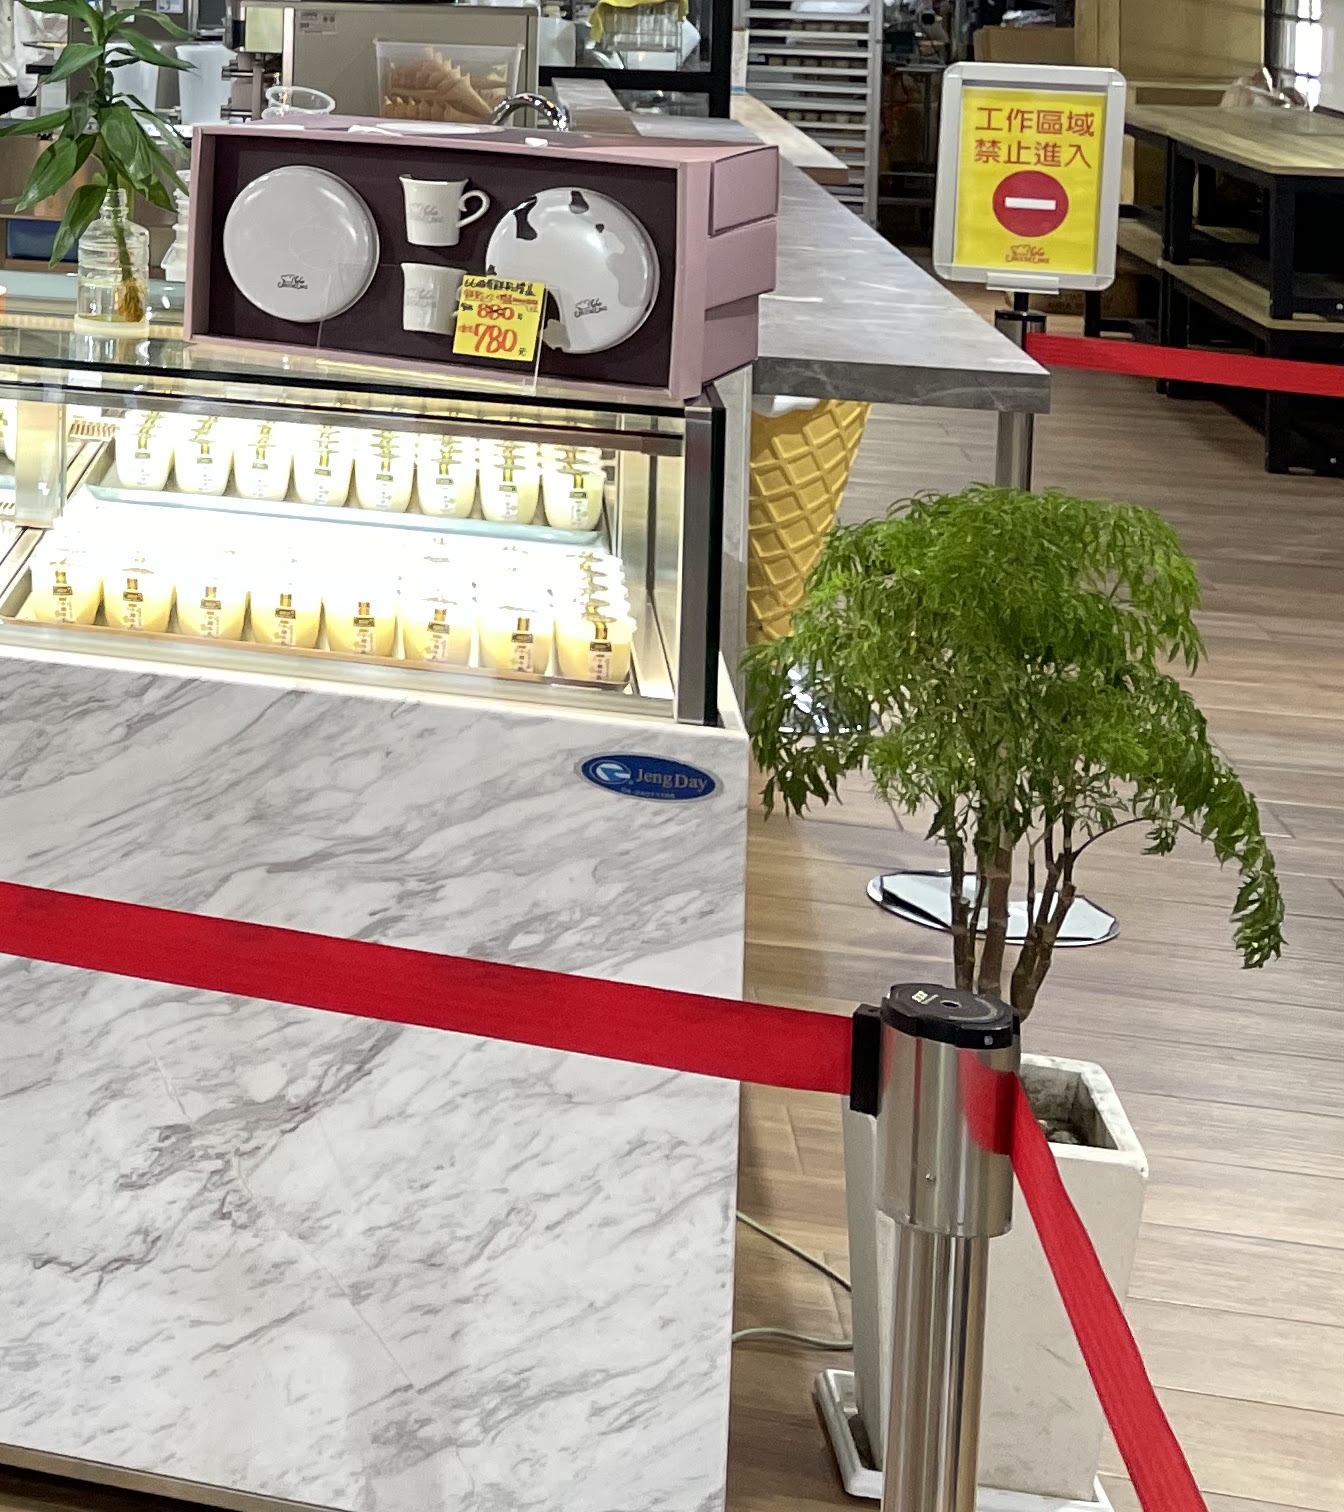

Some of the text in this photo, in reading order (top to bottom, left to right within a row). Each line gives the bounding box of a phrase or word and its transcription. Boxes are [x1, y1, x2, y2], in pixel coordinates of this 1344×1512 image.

[975, 107, 1095, 137] 工作區域
[974, 139, 1092, 169] 禁止進入
[474, 323, 518, 354] 780
